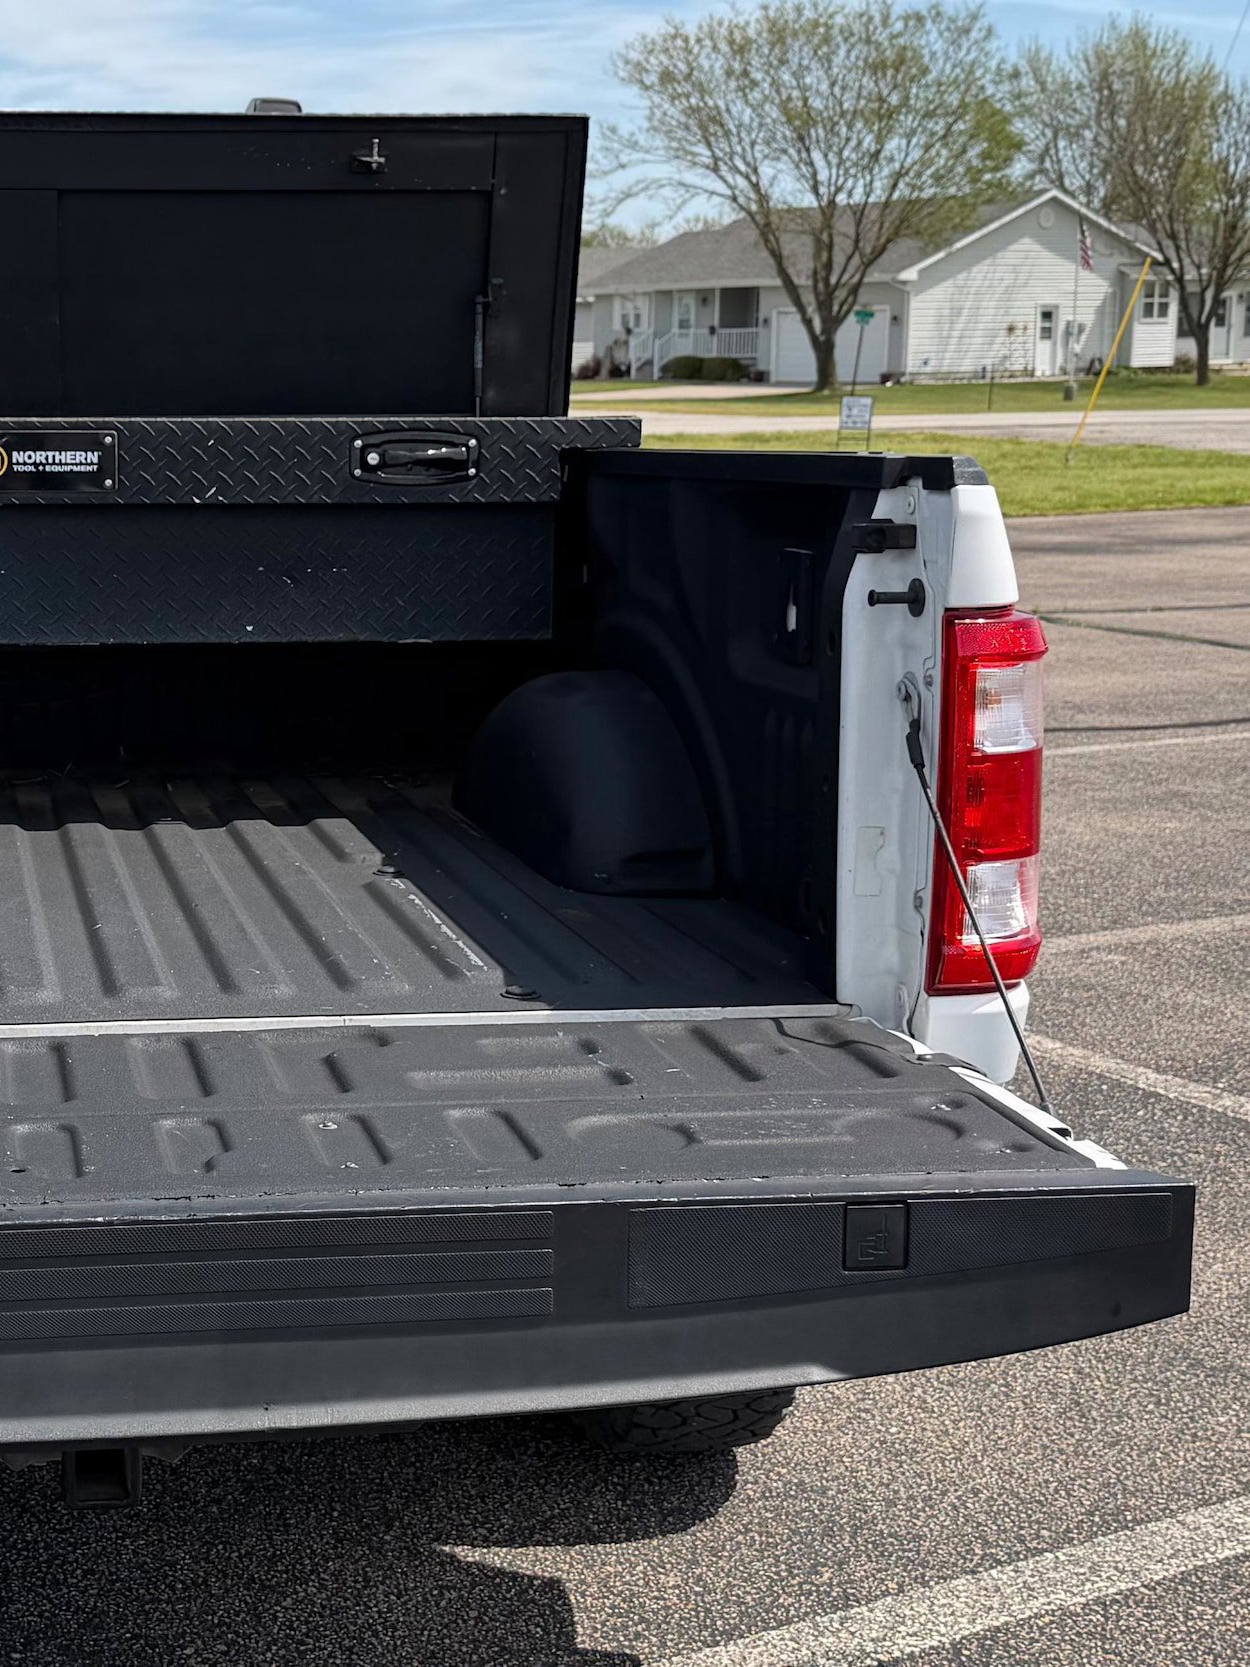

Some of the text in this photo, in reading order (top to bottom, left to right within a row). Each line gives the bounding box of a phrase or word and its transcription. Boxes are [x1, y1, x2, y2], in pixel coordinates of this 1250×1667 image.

[12, 451, 99, 464] NORTHERN
[12, 464, 37, 472] TOOL
[45, 464, 99, 472] EQUIPMENT
